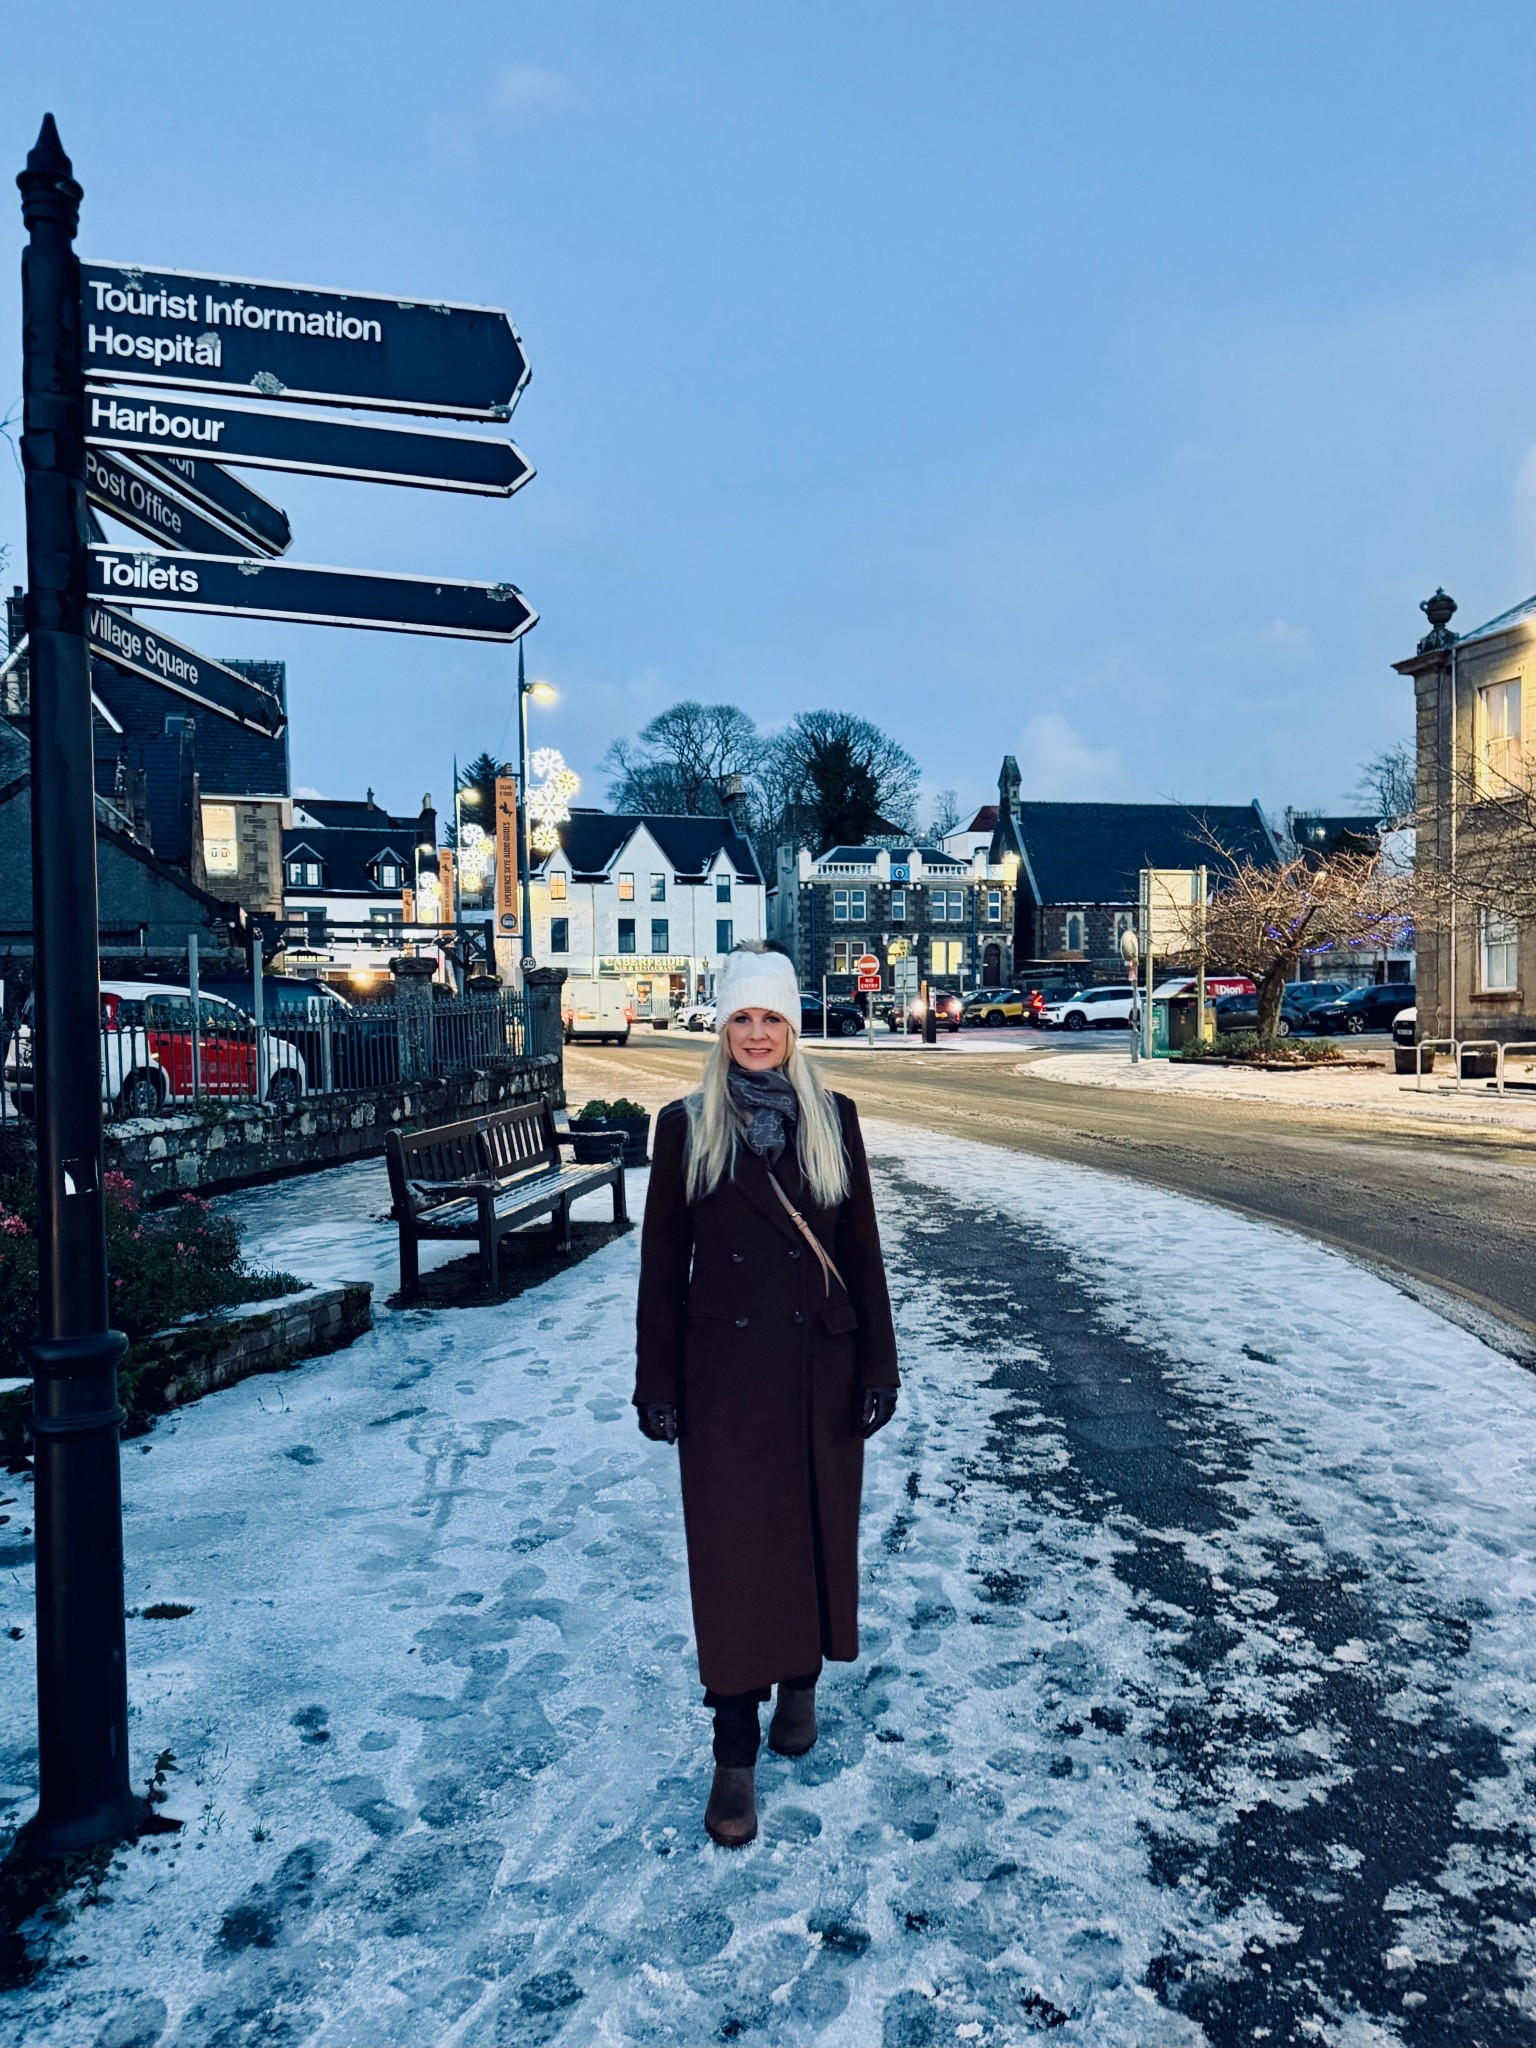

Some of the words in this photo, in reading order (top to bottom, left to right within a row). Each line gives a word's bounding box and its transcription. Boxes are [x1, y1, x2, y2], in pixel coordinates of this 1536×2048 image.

[88, 280, 198, 322] Tourist
[205, 294, 382, 343] Information
[88, 323, 222, 368] Hospital
[91, 398, 225, 442] Harbour
[86, 451, 126, 502] Post
[129, 480, 182, 534] Office
[95, 555, 199, 593] Toilets
[90, 609, 142, 659] Village
[144, 635, 199, 685] Square
[502, 822, 511, 841] GUIDES
[503, 841, 511, 858] AUDIO
[504, 859, 512, 873] SKYE
[504, 873, 512, 907] EXPERIENCE
[523, 959, 534, 967] 20
[603, 957, 685, 967] CABERFEIDH
[1220, 984, 1242, 995] Dion
